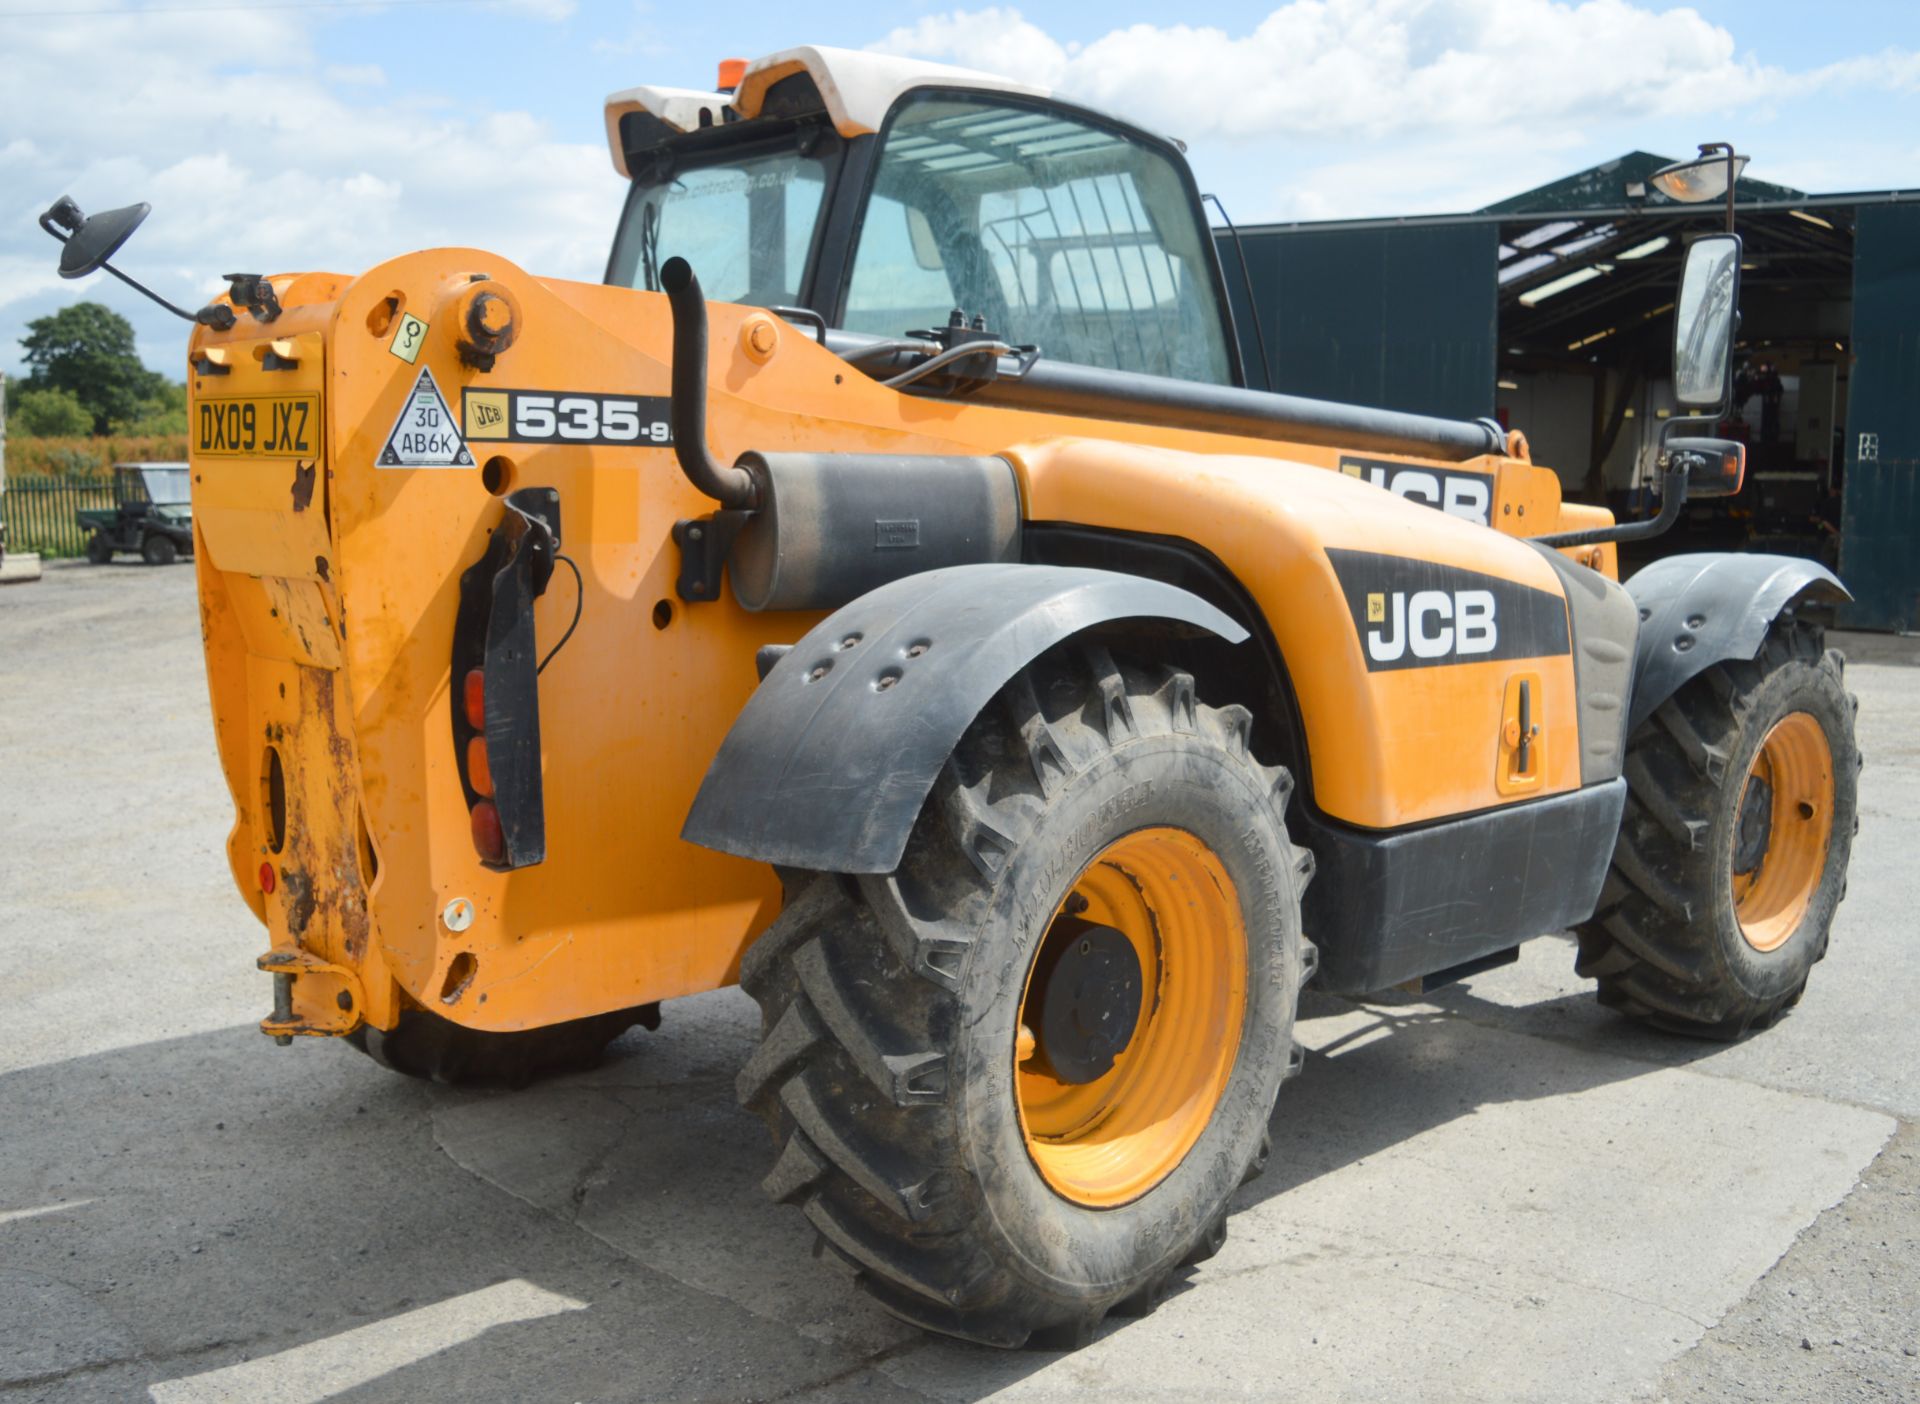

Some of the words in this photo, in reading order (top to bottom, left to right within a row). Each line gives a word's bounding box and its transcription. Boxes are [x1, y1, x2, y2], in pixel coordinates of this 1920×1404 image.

[201, 403, 256, 450] DX09
[264, 402, 309, 451] JXZ
[415, 408, 438, 428] 30
[477, 405, 502, 426] JCB
[516, 396, 674, 442] 535-9
[402, 433, 452, 454] AB6K
[1369, 468, 1489, 527] CB
[1368, 590, 1497, 661] JCB
[1241, 828, 1284, 991] IMPLEMENT
